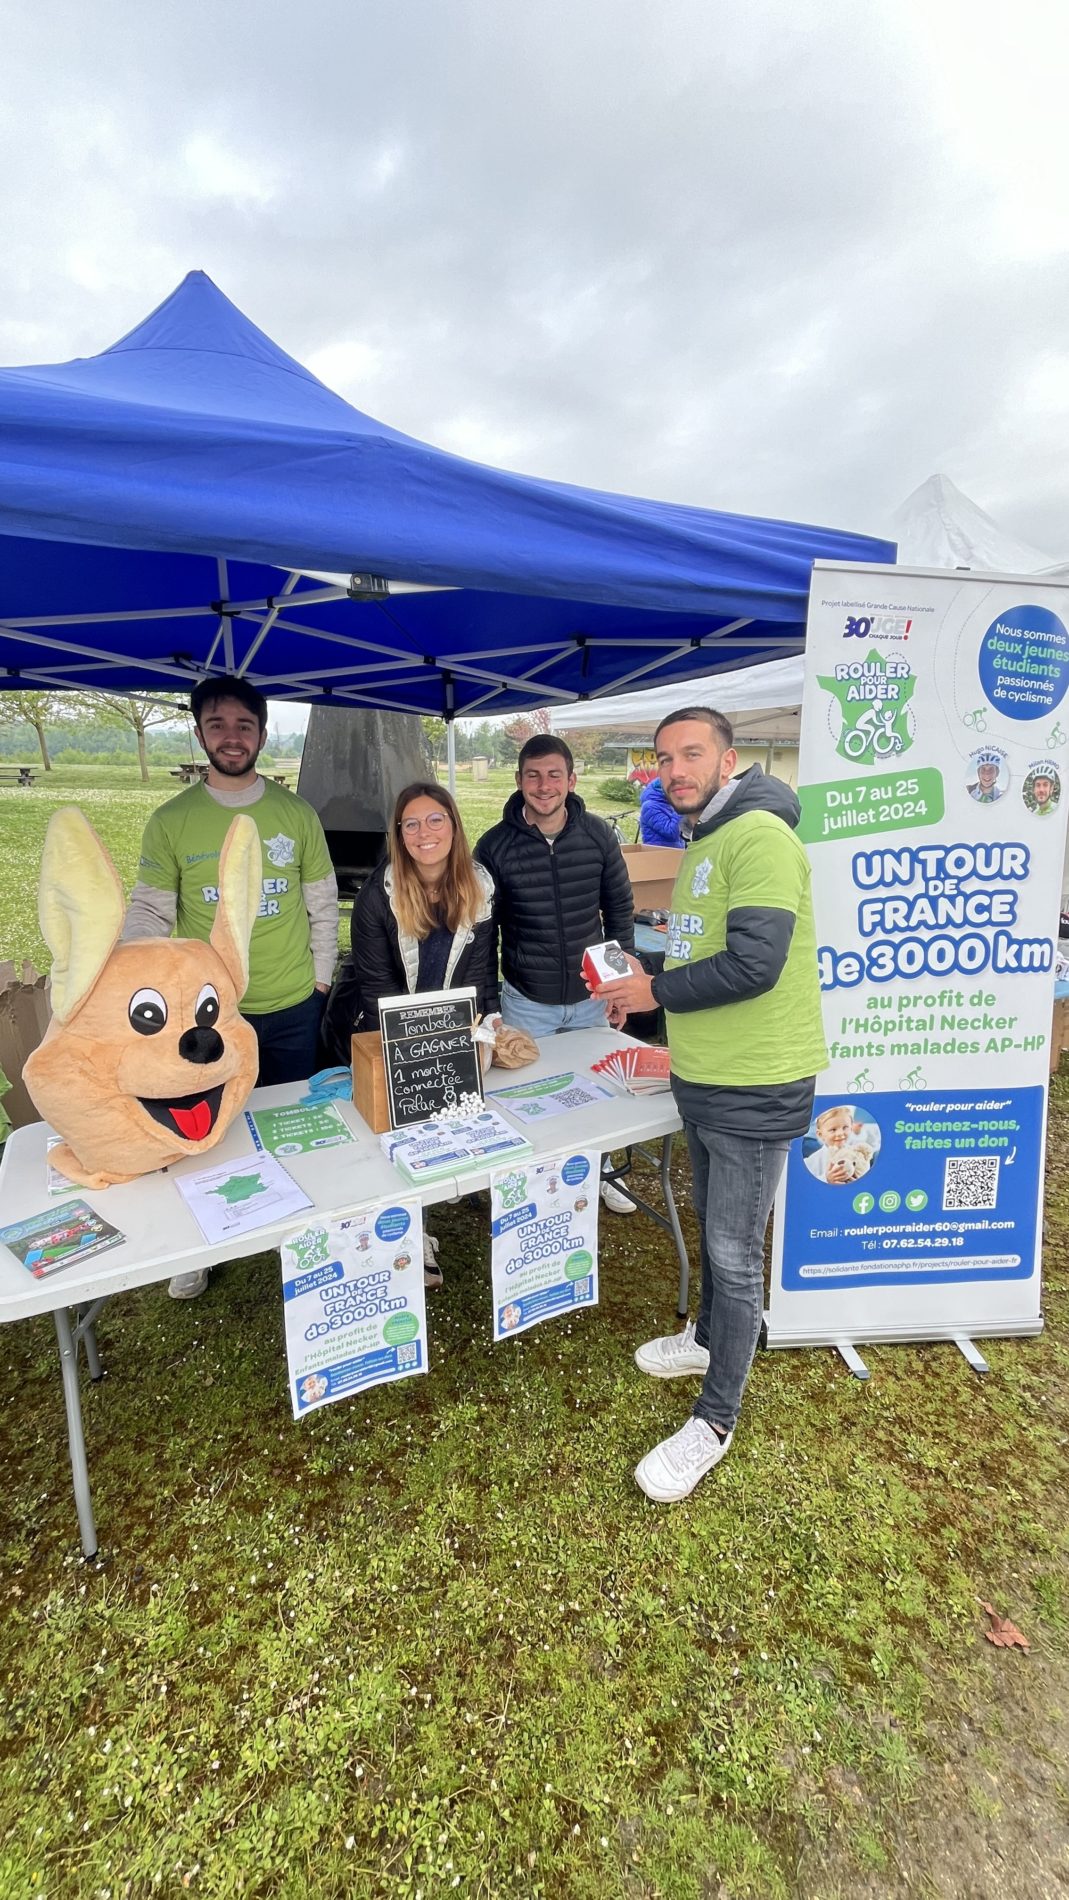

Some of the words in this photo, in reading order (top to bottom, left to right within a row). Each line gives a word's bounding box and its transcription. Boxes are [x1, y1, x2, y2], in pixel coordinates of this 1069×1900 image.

[907, 604, 935, 613] Nationale
[996, 623, 1022, 638] Nous
[1024, 628, 1066, 644] sommes
[988, 637, 1022, 654] deux
[1022, 642, 1068, 662] jeunes
[835, 662, 910, 681] ROULER
[992, 657, 1061, 678] étudiants
[860, 676, 887, 685] POUR
[997, 675, 1054, 692] passionnés
[847, 685, 899, 701] AIDER
[993, 687, 1006, 698] de
[1008, 690, 1052, 705] cyclisme
[826, 791, 853, 807] Du
[856, 787, 867, 803] 7
[870, 786, 892, 801] au
[896, 779, 919, 796] 25
[822, 807, 876, 834] juillet
[880, 801, 928, 821] 2024
[856, 852, 910, 885] UN
[918, 847, 1026, 878] TOUR
[928, 879, 957, 896] DE
[862, 894, 1013, 932] FRANCE
[870, 938, 986, 977] 3000
[998, 934, 1050, 968] km
[866, 995, 892, 1009] au
[898, 990, 964, 1012] profit
[969, 990, 996, 1007] de
[398, 1014, 463, 1037] Tombola
[841, 1014, 934, 1036] l'Hôpital
[940, 1014, 1017, 1030] Necker
[410, 1036, 470, 1058] GAGNER
[827, 1042, 885, 1059] fants
[890, 1038, 979, 1055] malades
[985, 1035, 1045, 1052] AP-HP
[394, 1069, 405, 1084] 1
[411, 1058, 456, 1079] montre
[946, 1101, 974, 1113] pour
[894, 1120, 1020, 1134] Soutenez-nous,
[905, 1136, 951, 1150] faites
[955, 1138, 974, 1148] un
[978, 1135, 1008, 1147] don
[500, 1221, 516, 1233] juillet
[518, 1224, 536, 1237] UN
[538, 1212, 570, 1229] TOUR
[810, 1228, 838, 1238] Email
[844, 1220, 1014, 1236] roulerpouraider60@gmail.com
[521, 1226, 568, 1251] FRANCE
[862, 1240, 877, 1250] Tél
[883, 1237, 964, 1249] 07.62.54.29.18
[507, 1257, 523, 1274] de
[524, 1242, 560, 1263] 3000
[563, 1237, 583, 1250] km
[294, 1281, 317, 1296] juillet
[318, 1272, 338, 1285] 2024
[295, 1279, 306, 1287] Du
[321, 1285, 344, 1300] UN
[346, 1271, 390, 1292] TOUR
[325, 1287, 386, 1315] FRANCE
[306, 1324, 329, 1340] de
[331, 1305, 377, 1328] 3000
[380, 1297, 406, 1312] km
[338, 1327, 364, 1342] profit
[366, 1323, 378, 1331] de
[304, 1345, 344, 1362] l'Hôpital
[346, 1332, 378, 1346] Necker
[295, 1361, 324, 1375] Enfants
[325, 1350, 356, 1364] malades
